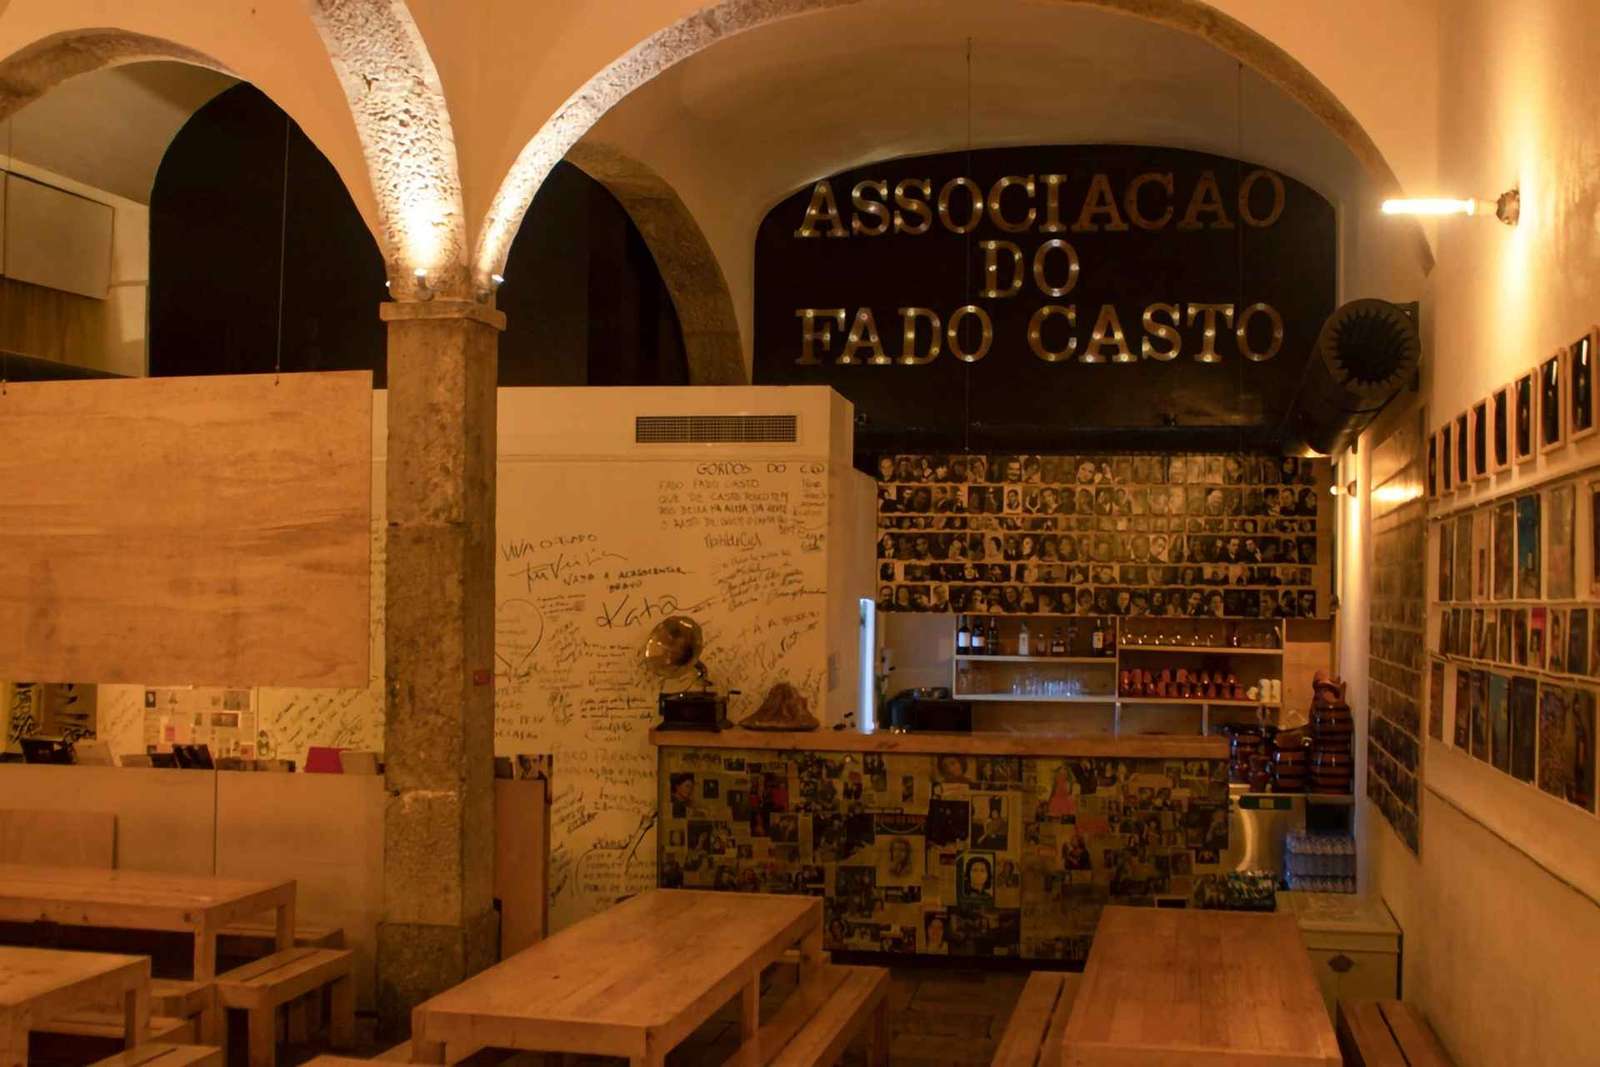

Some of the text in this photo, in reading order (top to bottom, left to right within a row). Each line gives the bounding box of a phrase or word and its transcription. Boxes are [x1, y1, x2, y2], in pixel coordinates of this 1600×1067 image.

[794, 170, 1286, 238] ASSOCIACAO
[979, 238, 1080, 298] DO
[794, 302, 1284, 365] FADO CASTO
